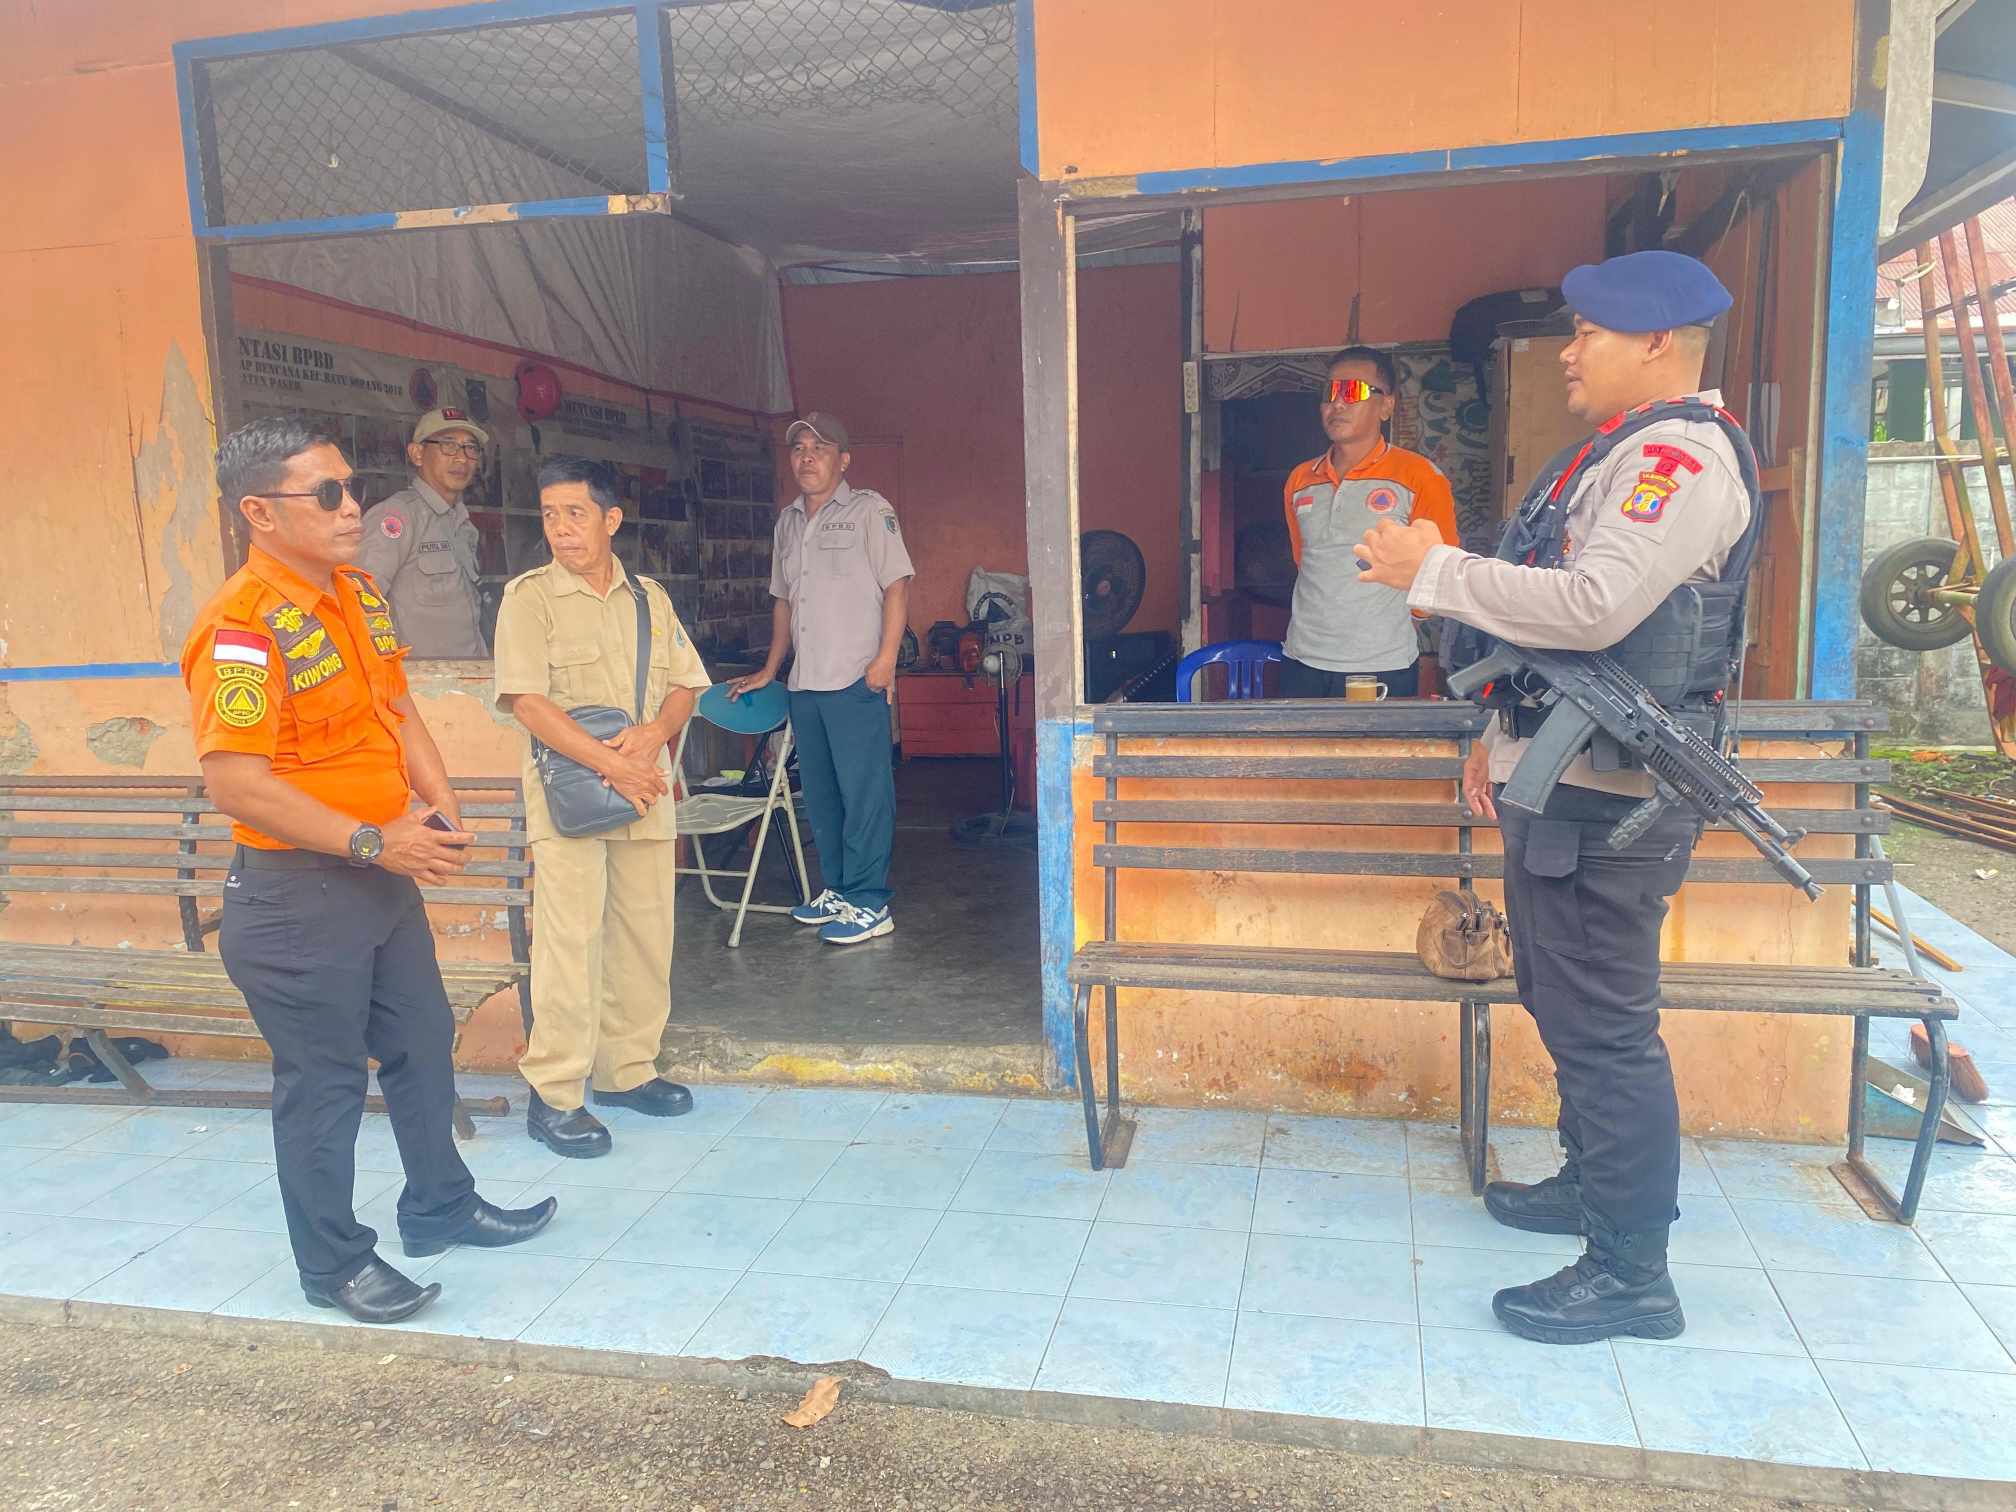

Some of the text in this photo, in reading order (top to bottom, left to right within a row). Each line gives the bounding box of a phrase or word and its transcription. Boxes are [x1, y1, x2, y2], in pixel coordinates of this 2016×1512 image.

[292, 345, 334, 370] BPBD
[223, 667, 262, 681] BPBD
[292, 653, 343, 692] KIWONG
